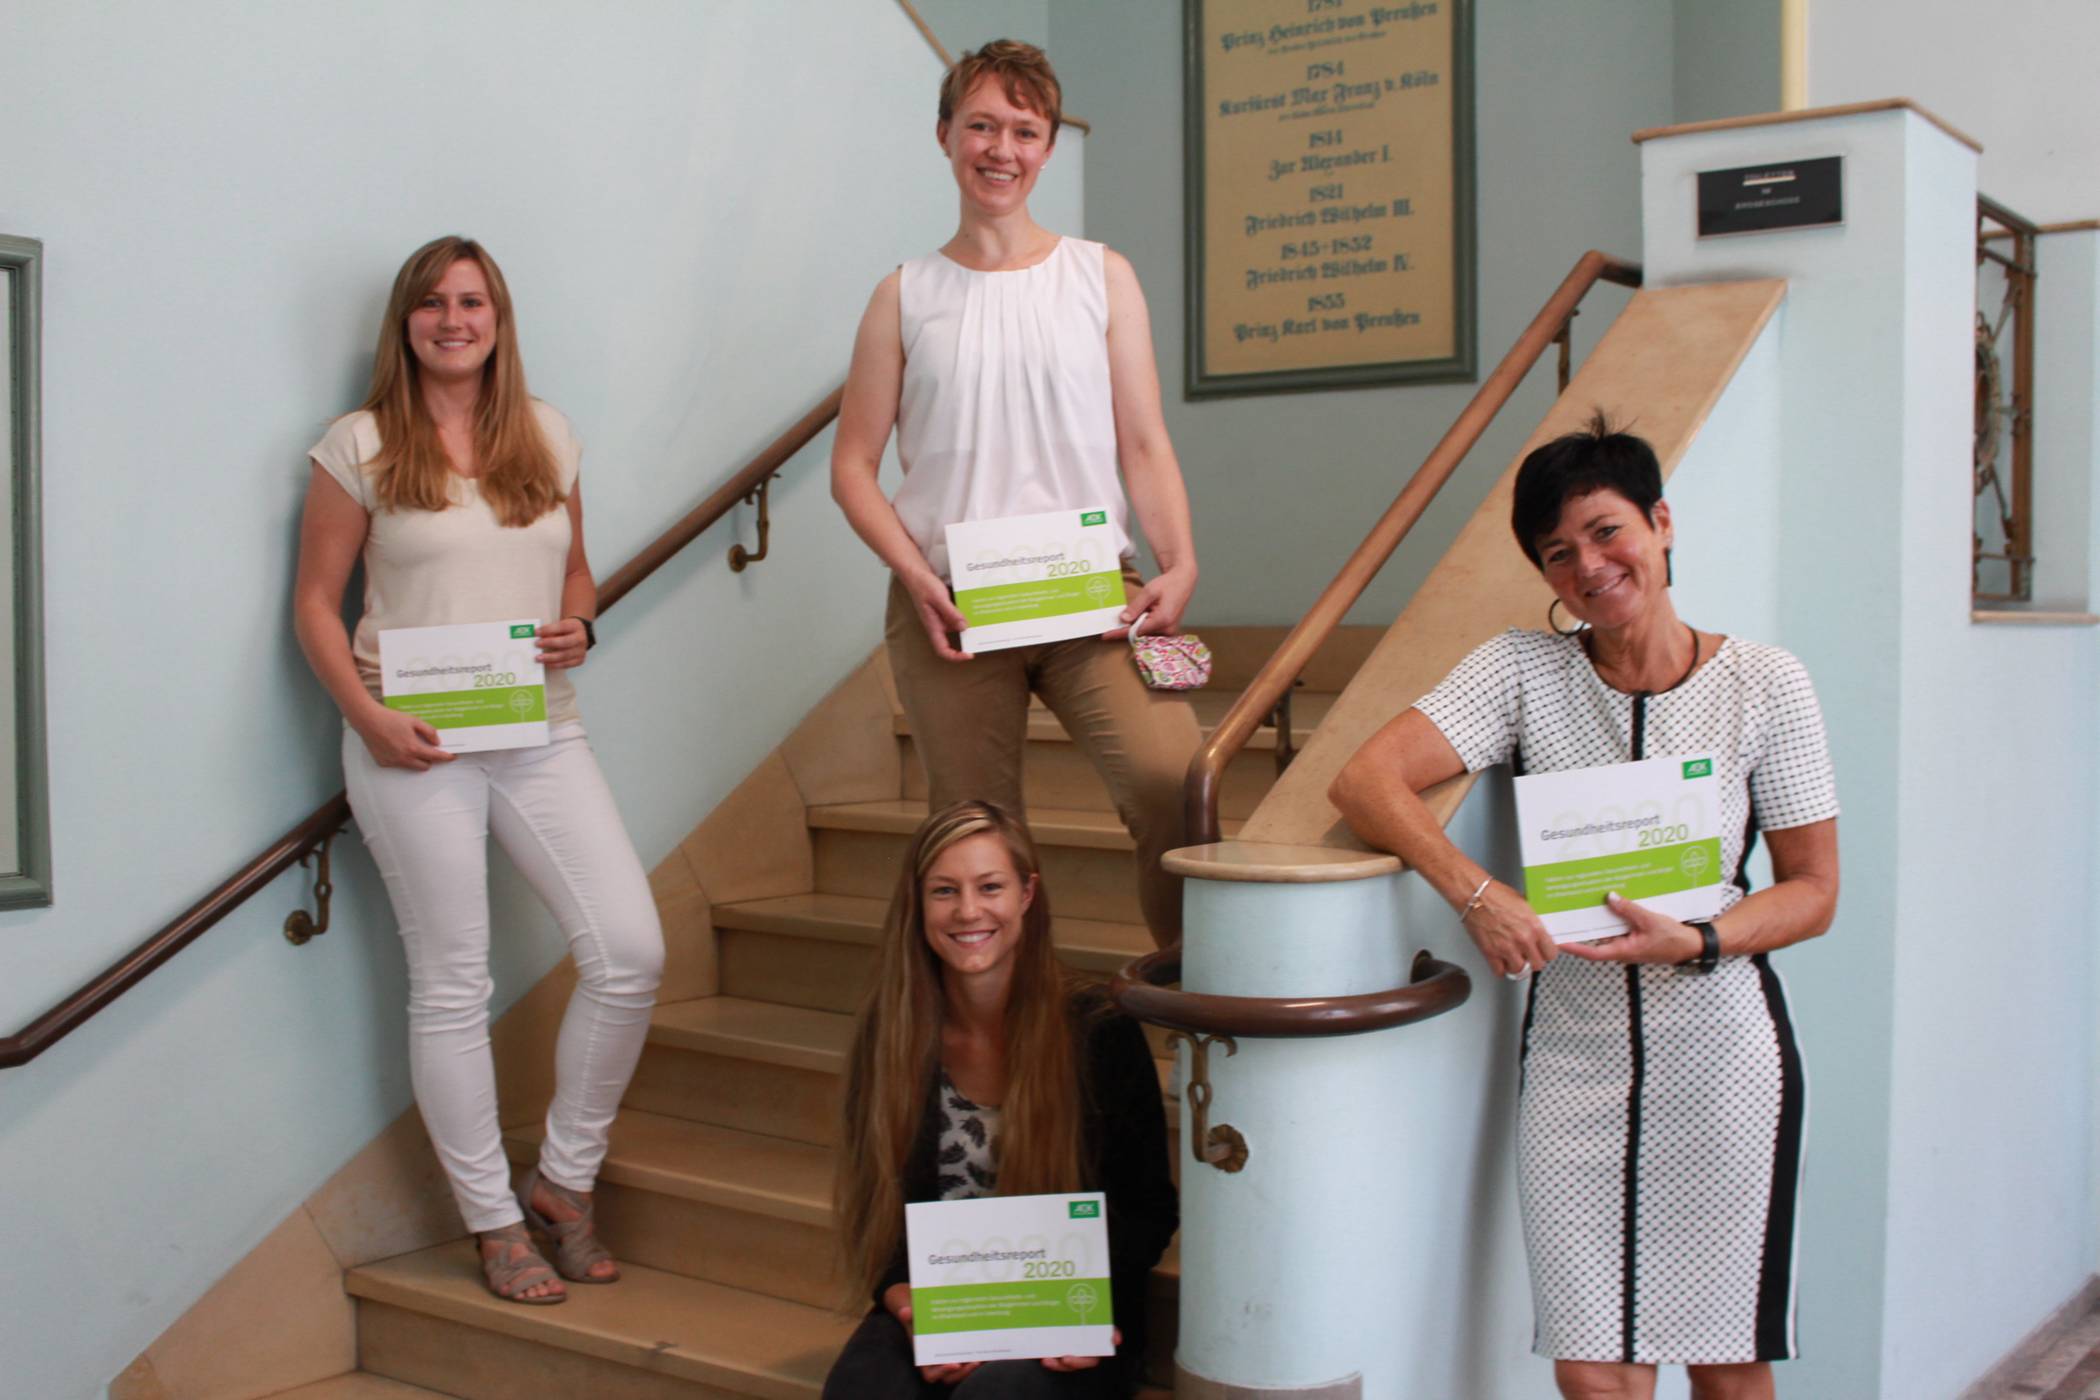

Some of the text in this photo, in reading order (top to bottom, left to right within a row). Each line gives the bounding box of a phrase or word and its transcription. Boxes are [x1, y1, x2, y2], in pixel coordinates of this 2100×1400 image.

[1245, 209, 1317, 236] Friedrich
[1320, 203, 1387, 225] Wilhelm
[1246, 264, 1317, 290] Friedrich
[1321, 258, 1387, 279] Wilhelm
[1234, 322, 1278, 343] Prinz
[966, 552, 1065, 571] Gesundheitsreport
[1047, 560, 1091, 577] 2020
[396, 663, 493, 678] Gesundheitsreport
[474, 672, 516, 688] 2020
[1540, 815, 1661, 841] Gesundheitsreport
[1638, 823, 1689, 848] 2020
[928, 1248, 1046, 1265] Gesundheitsreport
[1024, 1260, 1075, 1279] 2020
